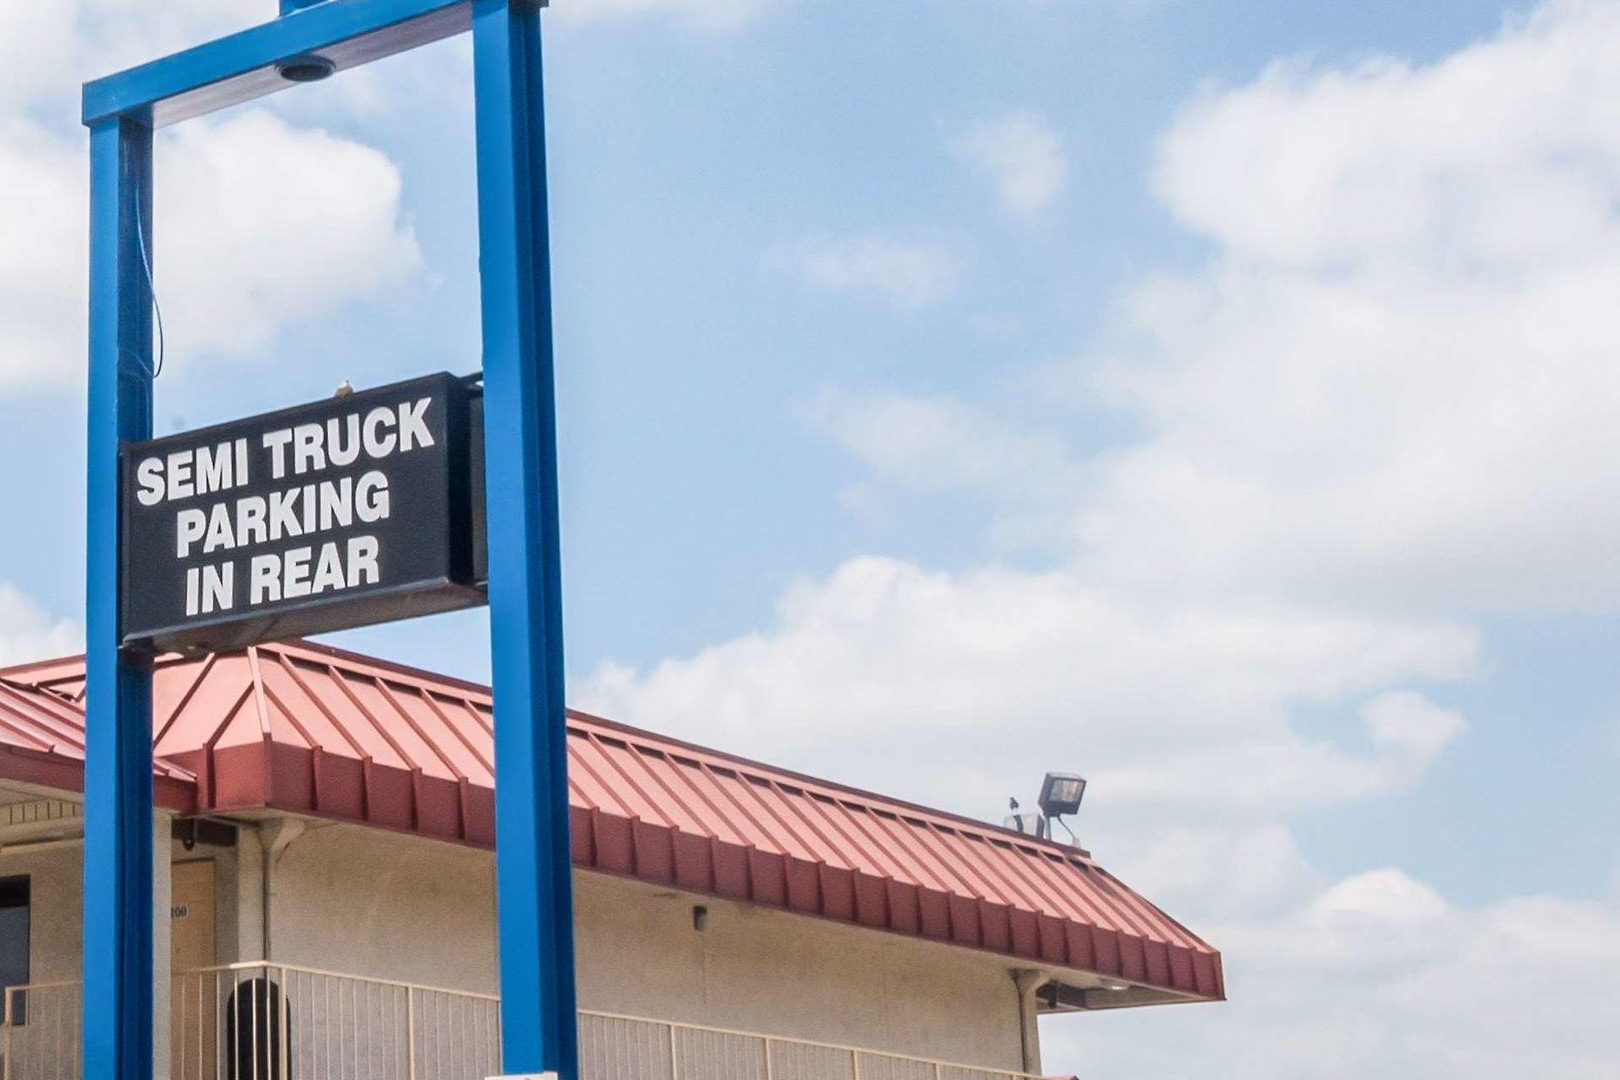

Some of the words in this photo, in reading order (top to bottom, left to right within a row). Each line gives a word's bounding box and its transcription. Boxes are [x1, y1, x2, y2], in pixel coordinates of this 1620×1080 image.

[137, 438, 248, 506] SEMI
[263, 397, 435, 479] TRUCK
[177, 471, 390, 558] PARKING
[185, 561, 234, 616] IN
[250, 535, 379, 605] REAR
